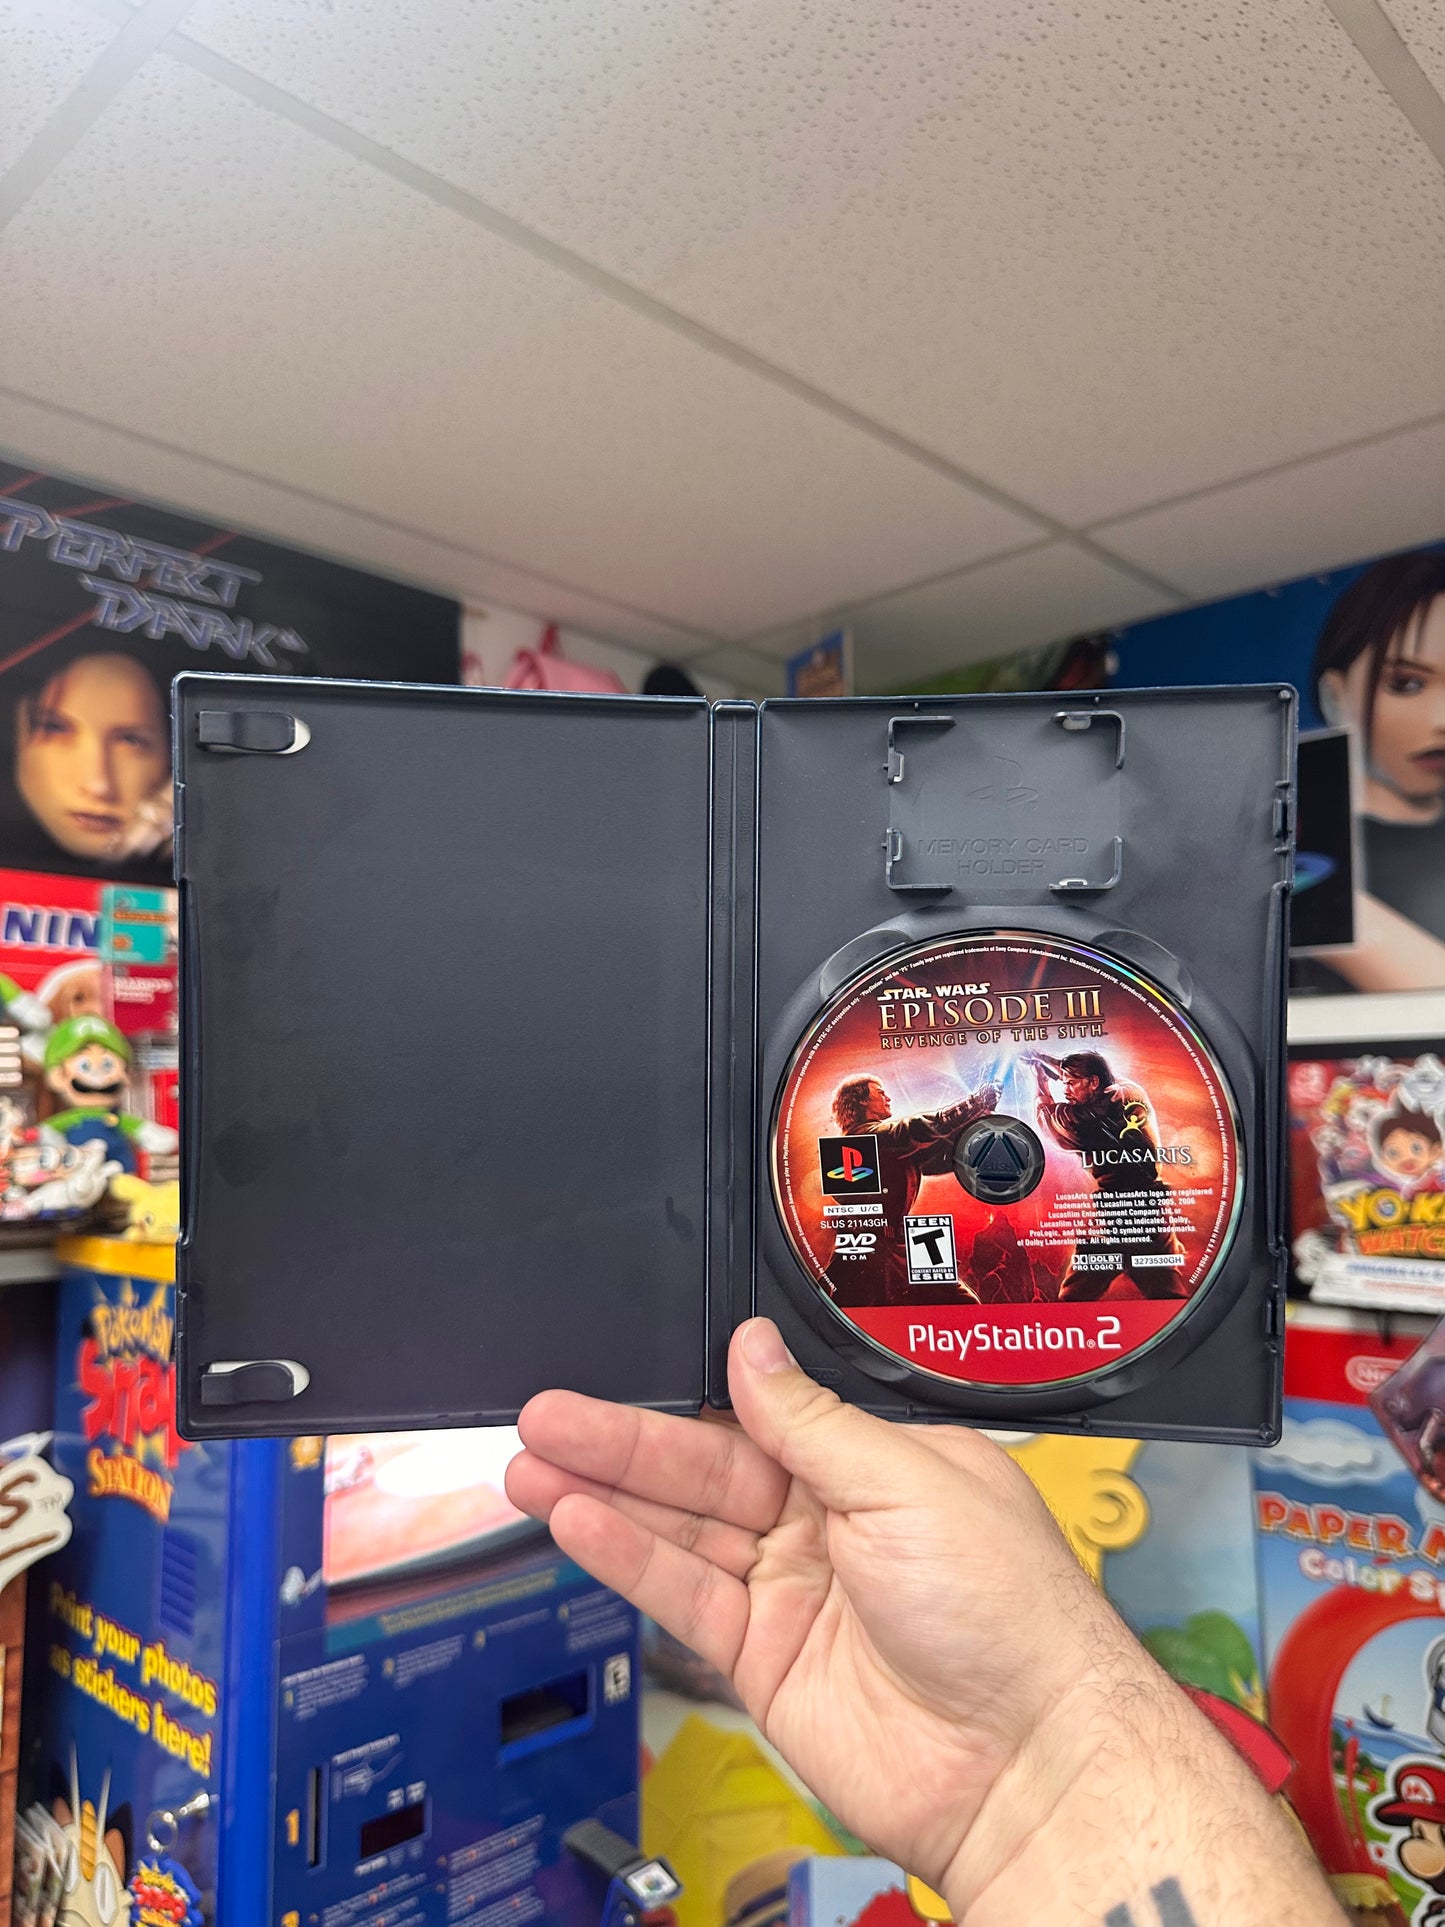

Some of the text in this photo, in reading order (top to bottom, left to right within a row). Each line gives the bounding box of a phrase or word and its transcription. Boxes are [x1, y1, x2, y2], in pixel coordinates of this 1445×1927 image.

[0, 495, 263, 608] PERFECT
[78, 573, 279, 668] DARK
[918, 837, 1089, 856] MEMORY CARD
[957, 859, 1046, 876] HOLDER
[877, 982, 990, 1001] STAR WARS
[879, 990, 1103, 1031] EPISODE III
[881, 1024, 1102, 1049] REVENGE OF THE SITH
[1056, 1193, 1087, 1201] LucasArts
[1149, 1190, 1164, 1198] logo
[1178, 1188, 1212, 1197] registered
[1048, 1211, 1080, 1219] Lucasfilm
[1082, 1209, 1128, 1218] Entertainment
[1129, 1208, 1159, 1217] Company
[1054, 1202, 1091, 1210] trademarks
[1100, 1200, 1132, 1208] Lucasfilm
[820, 1218, 888, 1229] SLUS 21143GH
[907, 1218, 950, 1227] TEEN
[1040, 1220, 1071, 1228] Lucasfilm
[1073, 1219, 1086, 1227] Ltd.
[1119, 1226, 1143, 1235] symbol
[1158, 1224, 1195, 1232] trademarks
[835, 1233, 877, 1247] DVD
[912, 1228, 945, 1266] T
[1025, 1238, 1044, 1247] Dolby
[1090, 1236, 1099, 1244] All
[1101, 1236, 1120, 1245] rights
[1134, 1257, 1182, 1265] 3273530GH
[1255, 1491, 1412, 1560] PAPER
[1299, 1546, 1401, 1595] Color
[51, 1581, 93, 1639] Print
[94, 1613, 141, 1664] your
[141, 1638, 217, 1716] photos
[72, 1658, 152, 1734] stickers
[153, 1701, 212, 1778] here!
